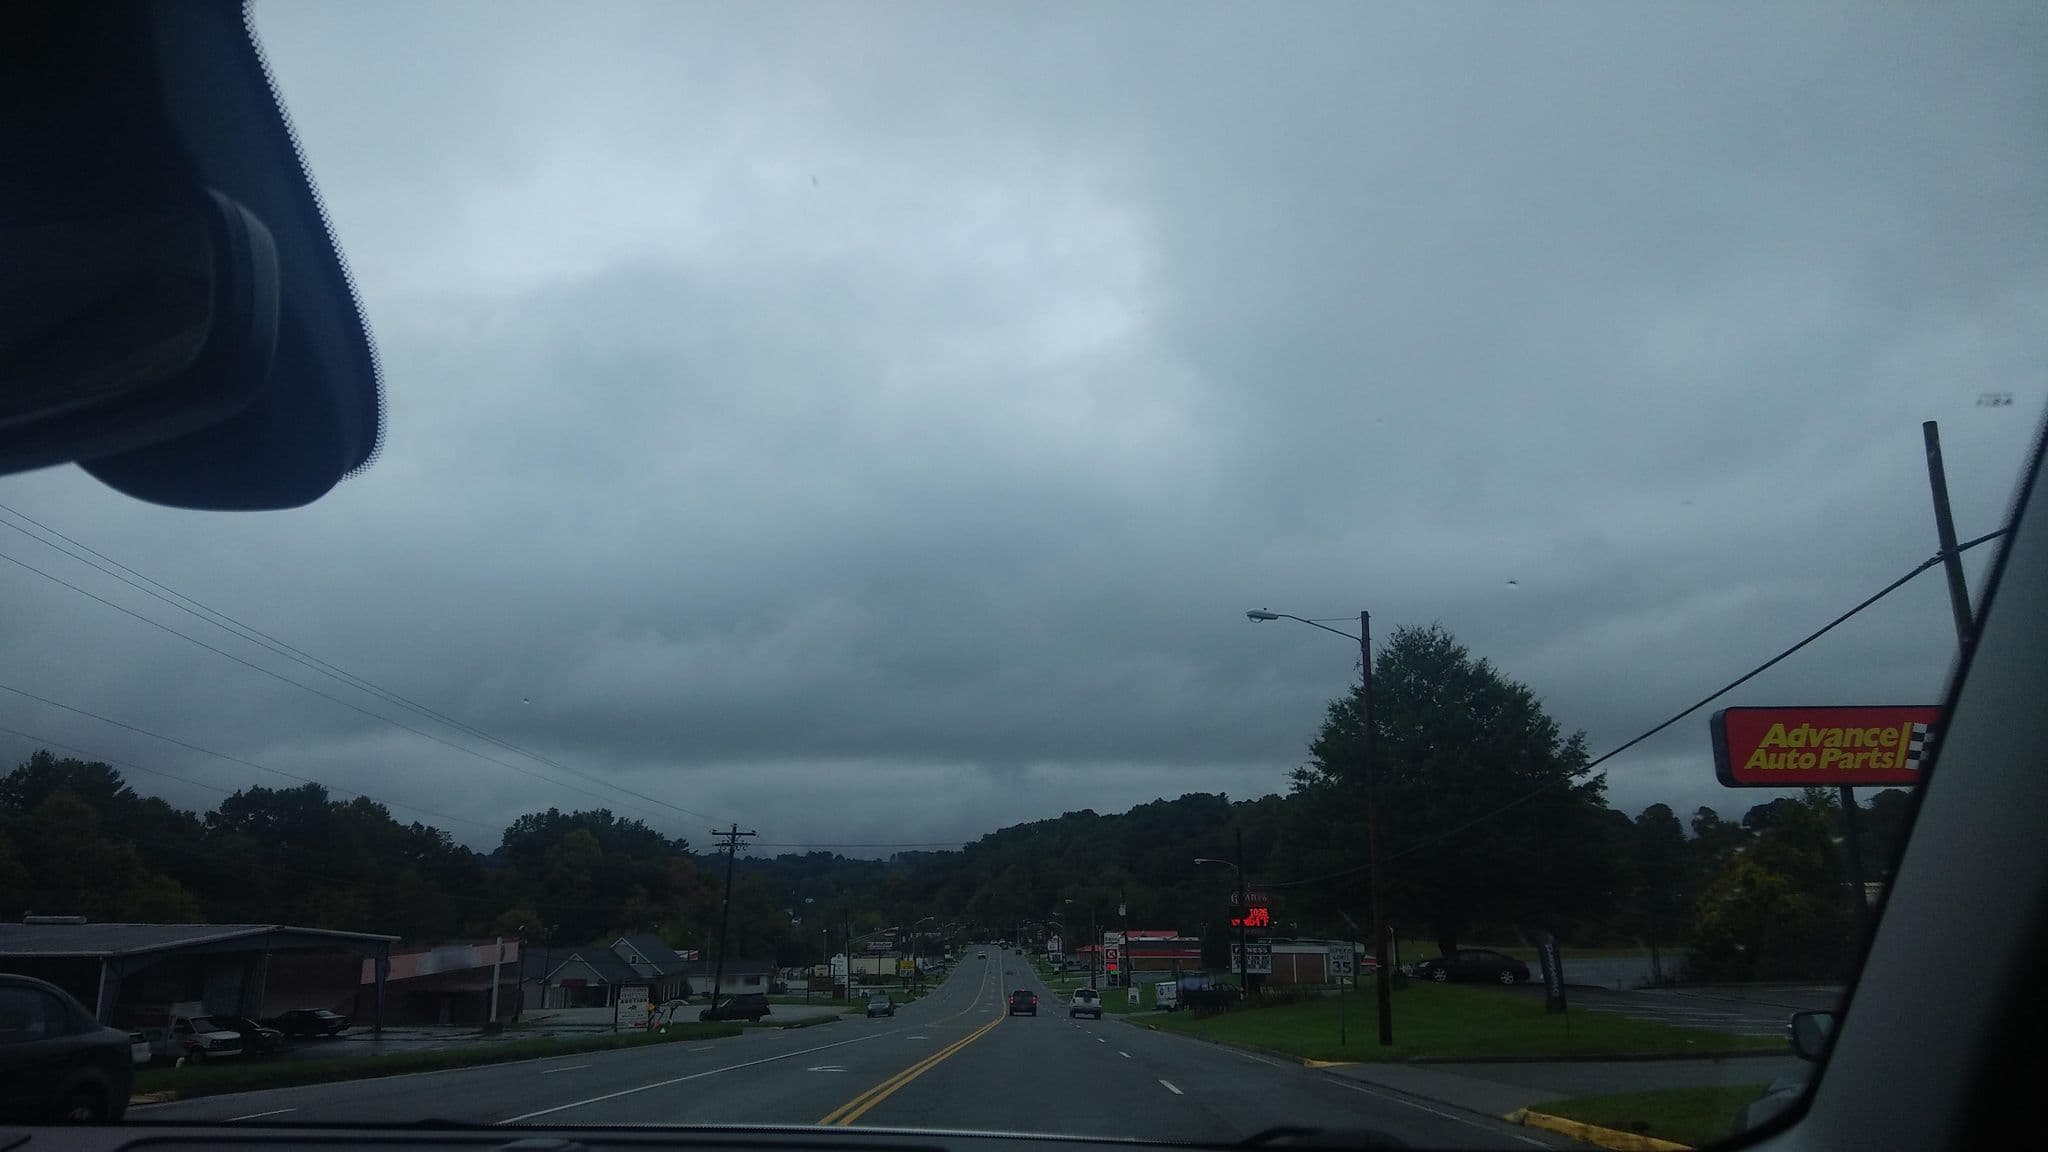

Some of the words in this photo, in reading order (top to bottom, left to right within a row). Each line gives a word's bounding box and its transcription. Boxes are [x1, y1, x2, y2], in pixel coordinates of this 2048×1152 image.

[1758, 722, 1899, 748] Advance
[1744, 748, 1817, 770] Auto
[1819, 747, 1896, 769] Parts
[1332, 961, 1352, 974] 35
